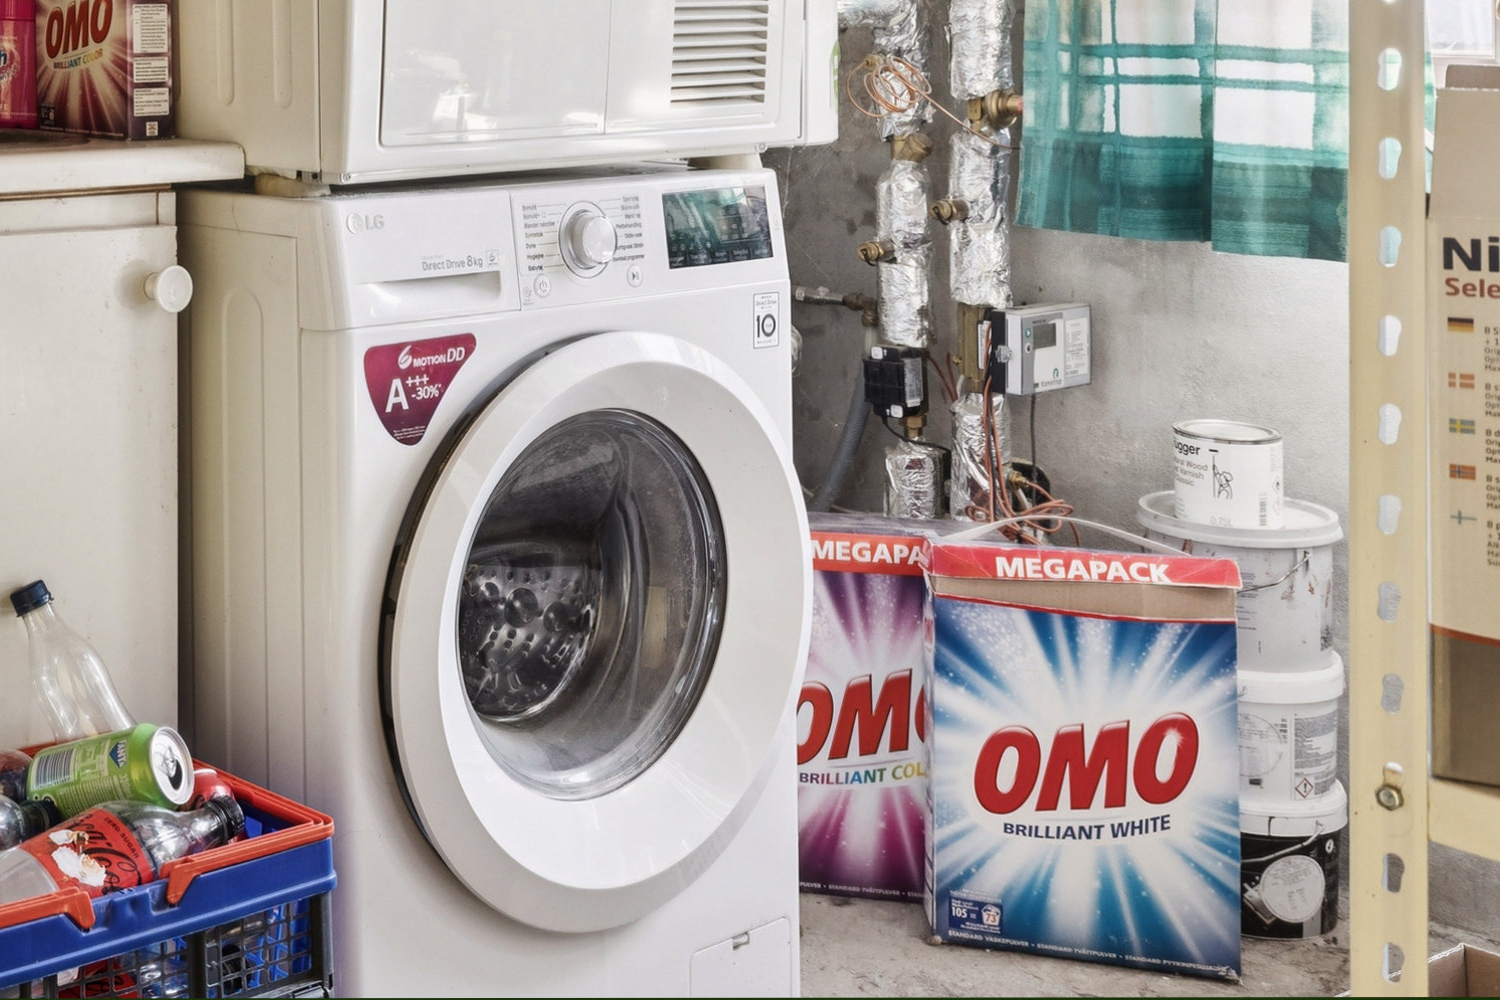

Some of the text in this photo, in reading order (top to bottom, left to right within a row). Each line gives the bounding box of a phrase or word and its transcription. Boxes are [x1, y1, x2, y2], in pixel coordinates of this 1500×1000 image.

[53, 48, 104, 70] BRILLIANT COLOR
[365, 214, 385, 230] LG
[422, 260, 445, 271] Direct
[446, 259, 466, 270] Drive
[756, 313, 776, 338] 10
[412, 354, 446, 367] MOTION
[446, 347, 466, 362] DD
[1186, 460, 1209, 471] Wood
[811, 539, 923, 565] MEGAPA
[995, 556, 1173, 584] MEGAPACK
[116, 739, 128, 769] FANTA
[974, 711, 1200, 816] OMO
[799, 761, 925, 785] BRILLIANT COL
[104, 816, 140, 858] ZERO SUGAR
[1002, 814, 1172, 841] BRILLIANT WHITE
[828, 884, 861, 892] STANDARD
[951, 906, 968, 919] 105
[985, 912, 998, 924] 73
[948, 930, 984, 941] STANDARD
[985, 936, 1029, 947] VASKEPULVER
[1037, 943, 1073, 953] STANDARD
[1074, 948, 1117, 959] TVÄTTPULVER
[1125, 955, 1162, 965] STANDARD
